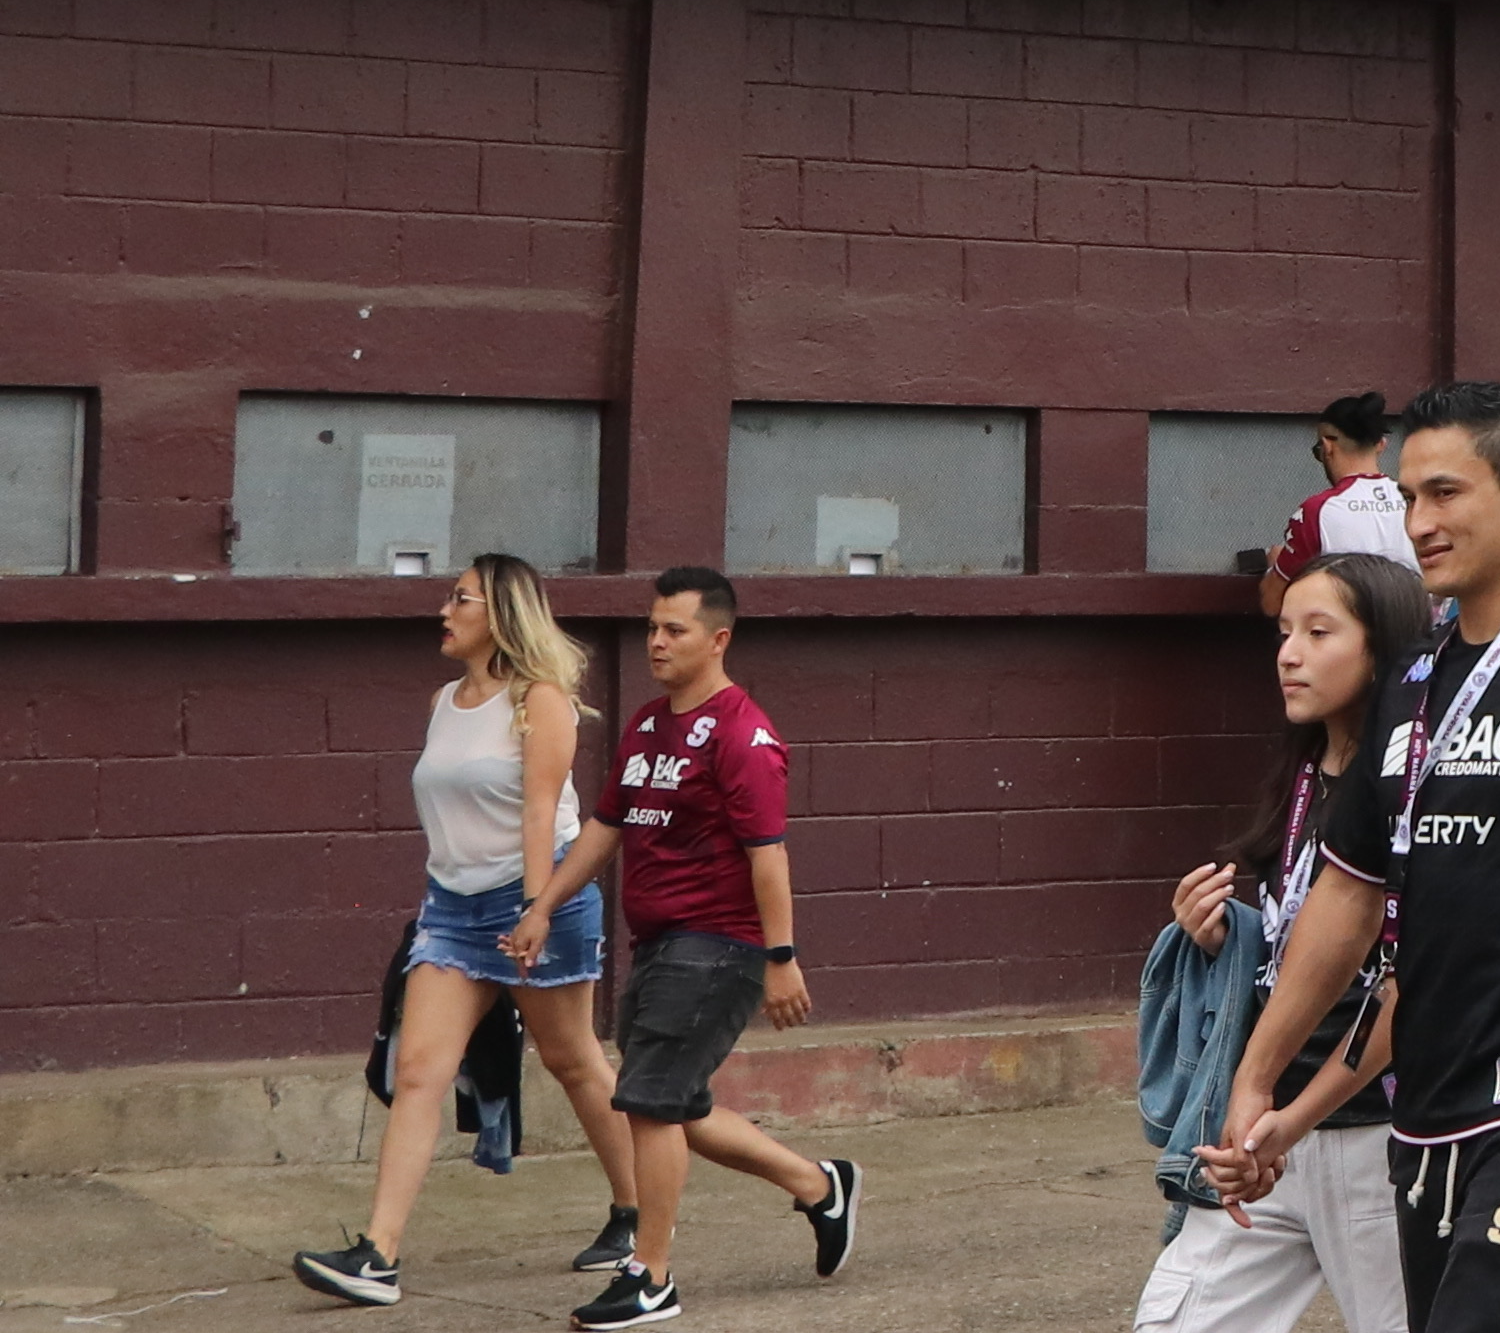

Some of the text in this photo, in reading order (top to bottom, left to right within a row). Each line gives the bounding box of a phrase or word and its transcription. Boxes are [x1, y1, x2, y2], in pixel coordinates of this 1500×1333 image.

[366, 473, 447, 488] CERRADA
[685, 715, 718, 748] S
[652, 753, 691, 781] BAC
[1386, 899, 1398, 919] S
